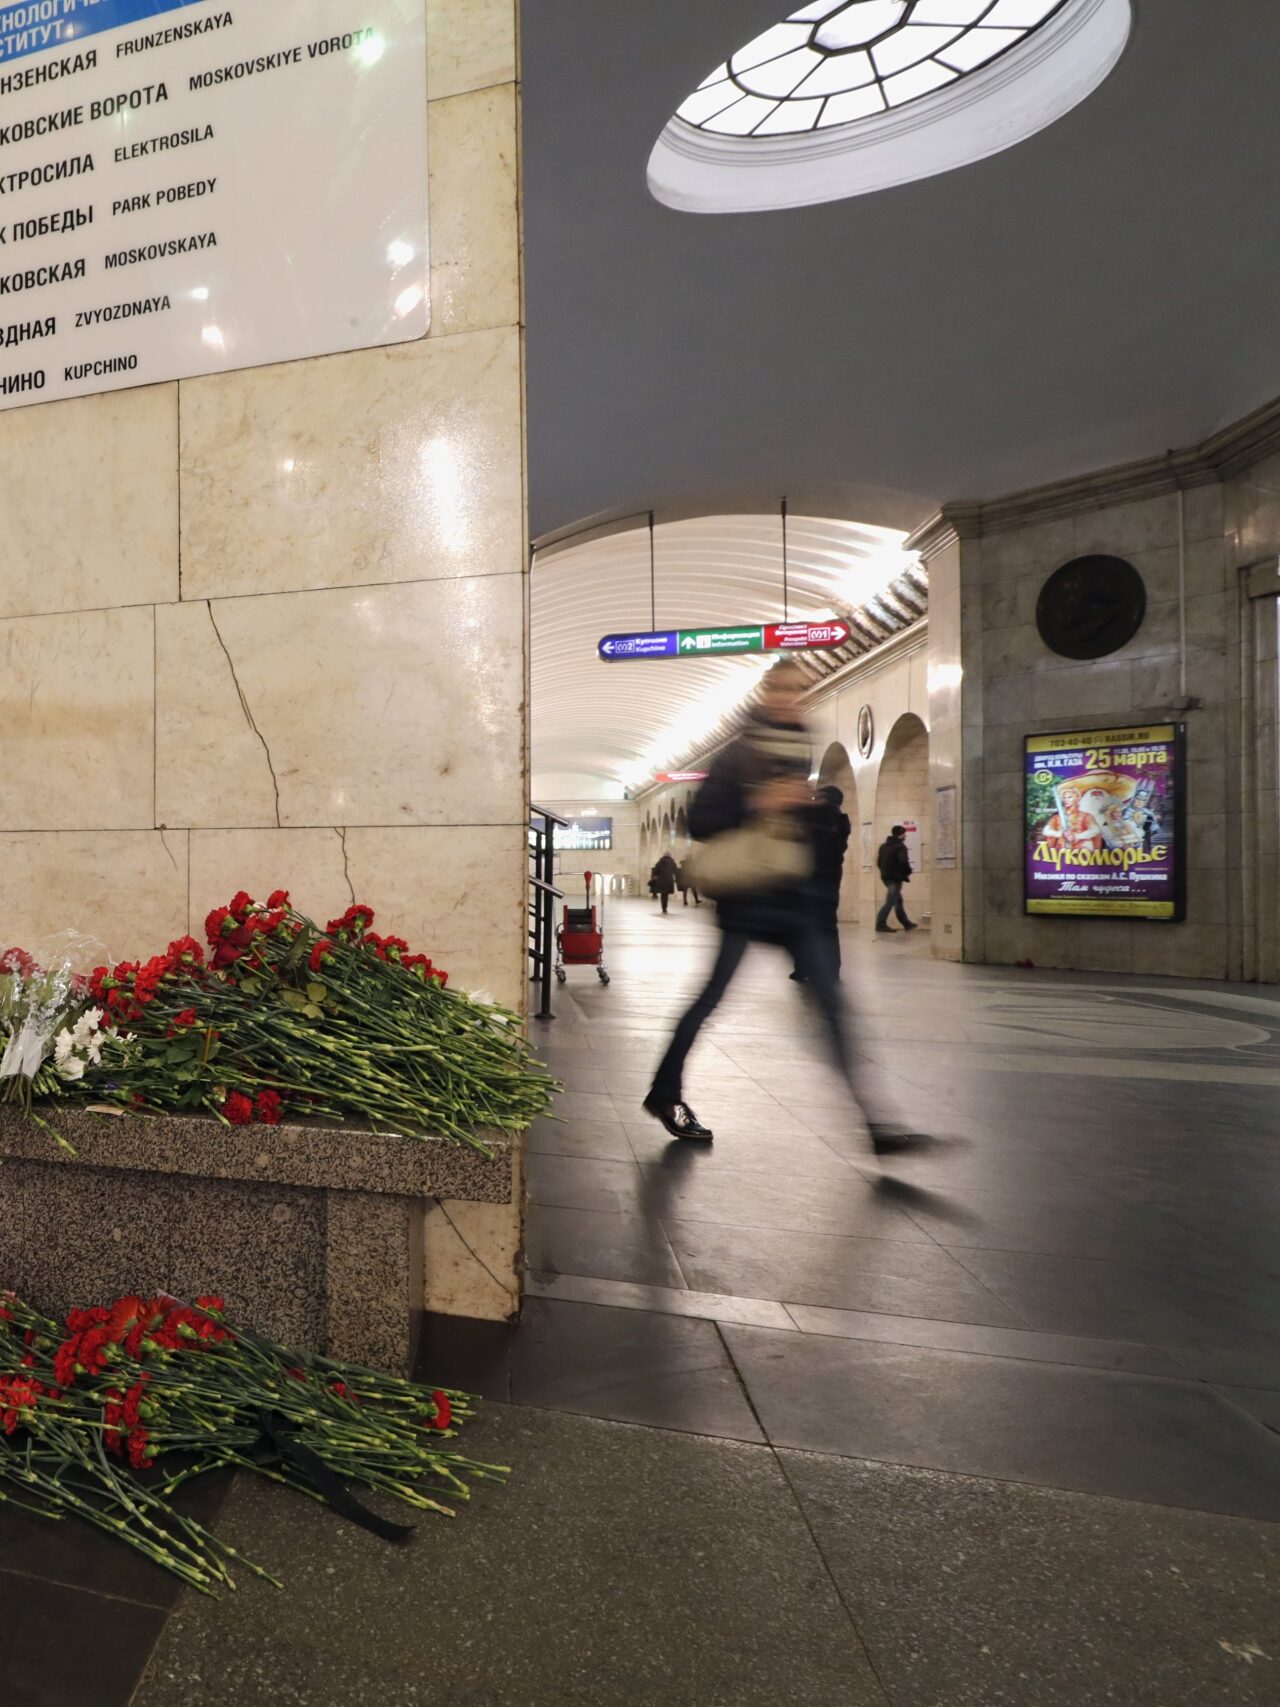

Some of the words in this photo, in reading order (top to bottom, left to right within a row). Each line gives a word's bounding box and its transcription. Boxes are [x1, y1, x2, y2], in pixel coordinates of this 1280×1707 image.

[116, 11, 233, 58] FRUNZENSKAYA
[189, 46, 302, 91] MOSKOVSKIYE
[90, 83, 169, 121] ВОРОТА
[114, 125, 214, 163] ELEKTROSILA
[112, 193, 151, 216] PARK
[156, 177, 217, 206] POBEDY
[13, 205, 93, 242] ПОБЕДЫ
[104, 232, 217, 270] MOSKOVSKAYA
[75, 295, 171, 328] ZVYOZDNAYA
[64, 354, 138, 382] KUPCHINO
[1085, 748, 1111, 769] 25
[1113, 751, 1167, 768] марта
